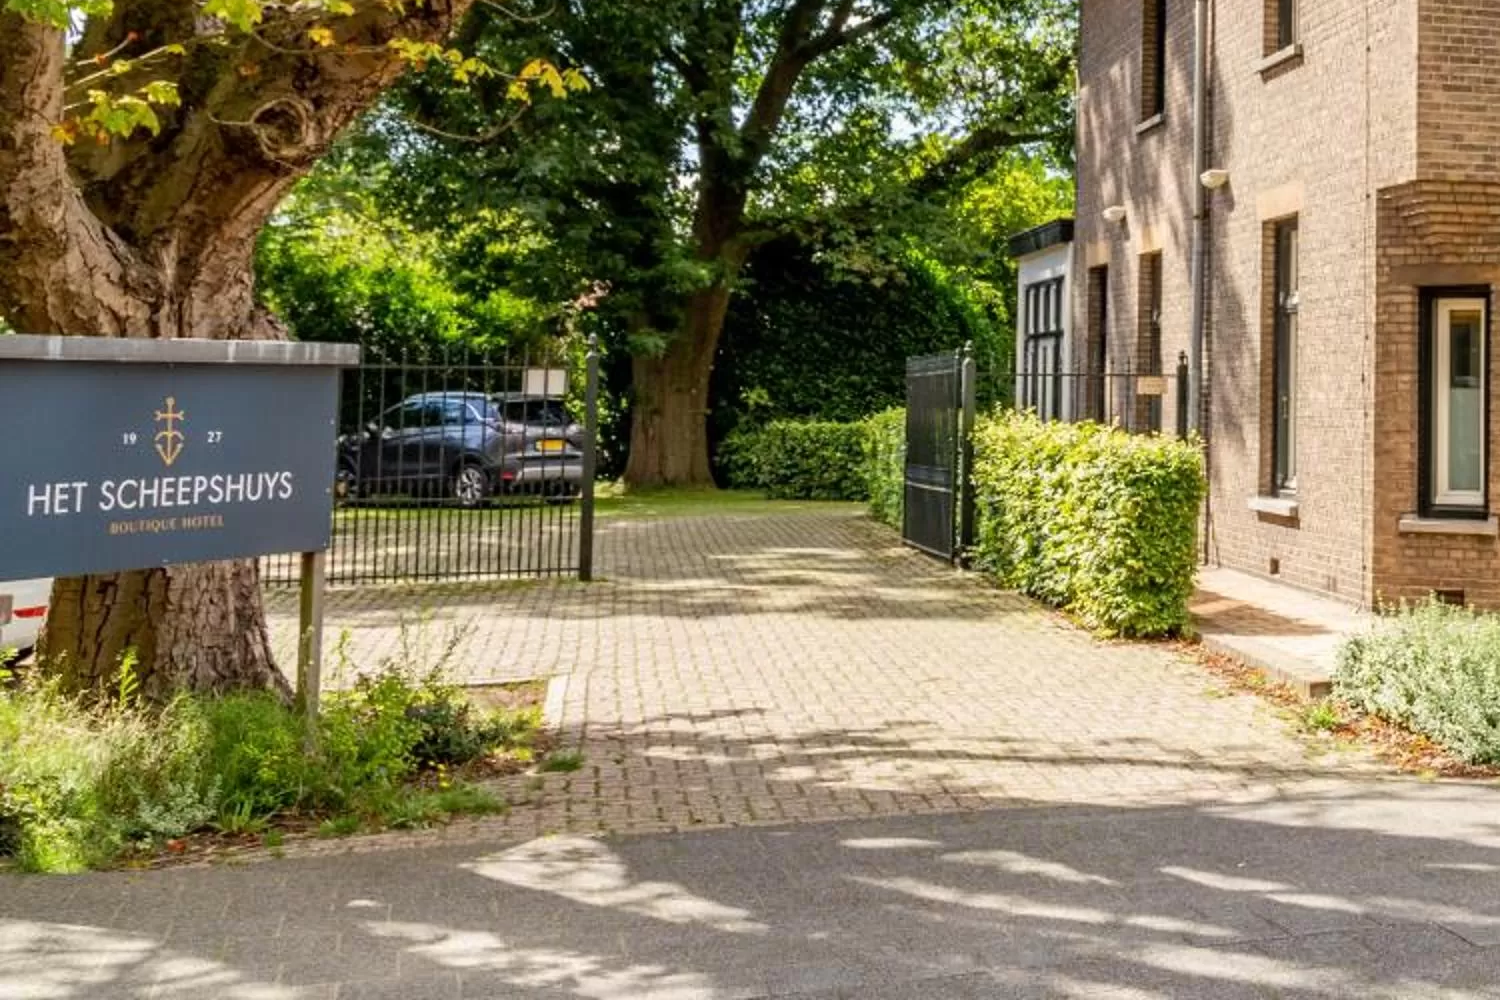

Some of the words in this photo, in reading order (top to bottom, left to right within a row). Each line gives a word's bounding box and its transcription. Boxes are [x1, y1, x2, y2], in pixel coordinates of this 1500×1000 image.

[123, 431, 137, 445] 19
[207, 431, 223, 443] 27
[27, 482, 88, 516] HET
[99, 471, 293, 511] SCHEEPSHUYS
[108, 518, 177, 535] BOUTIQUE
[182, 515, 225, 529] HOTEL
